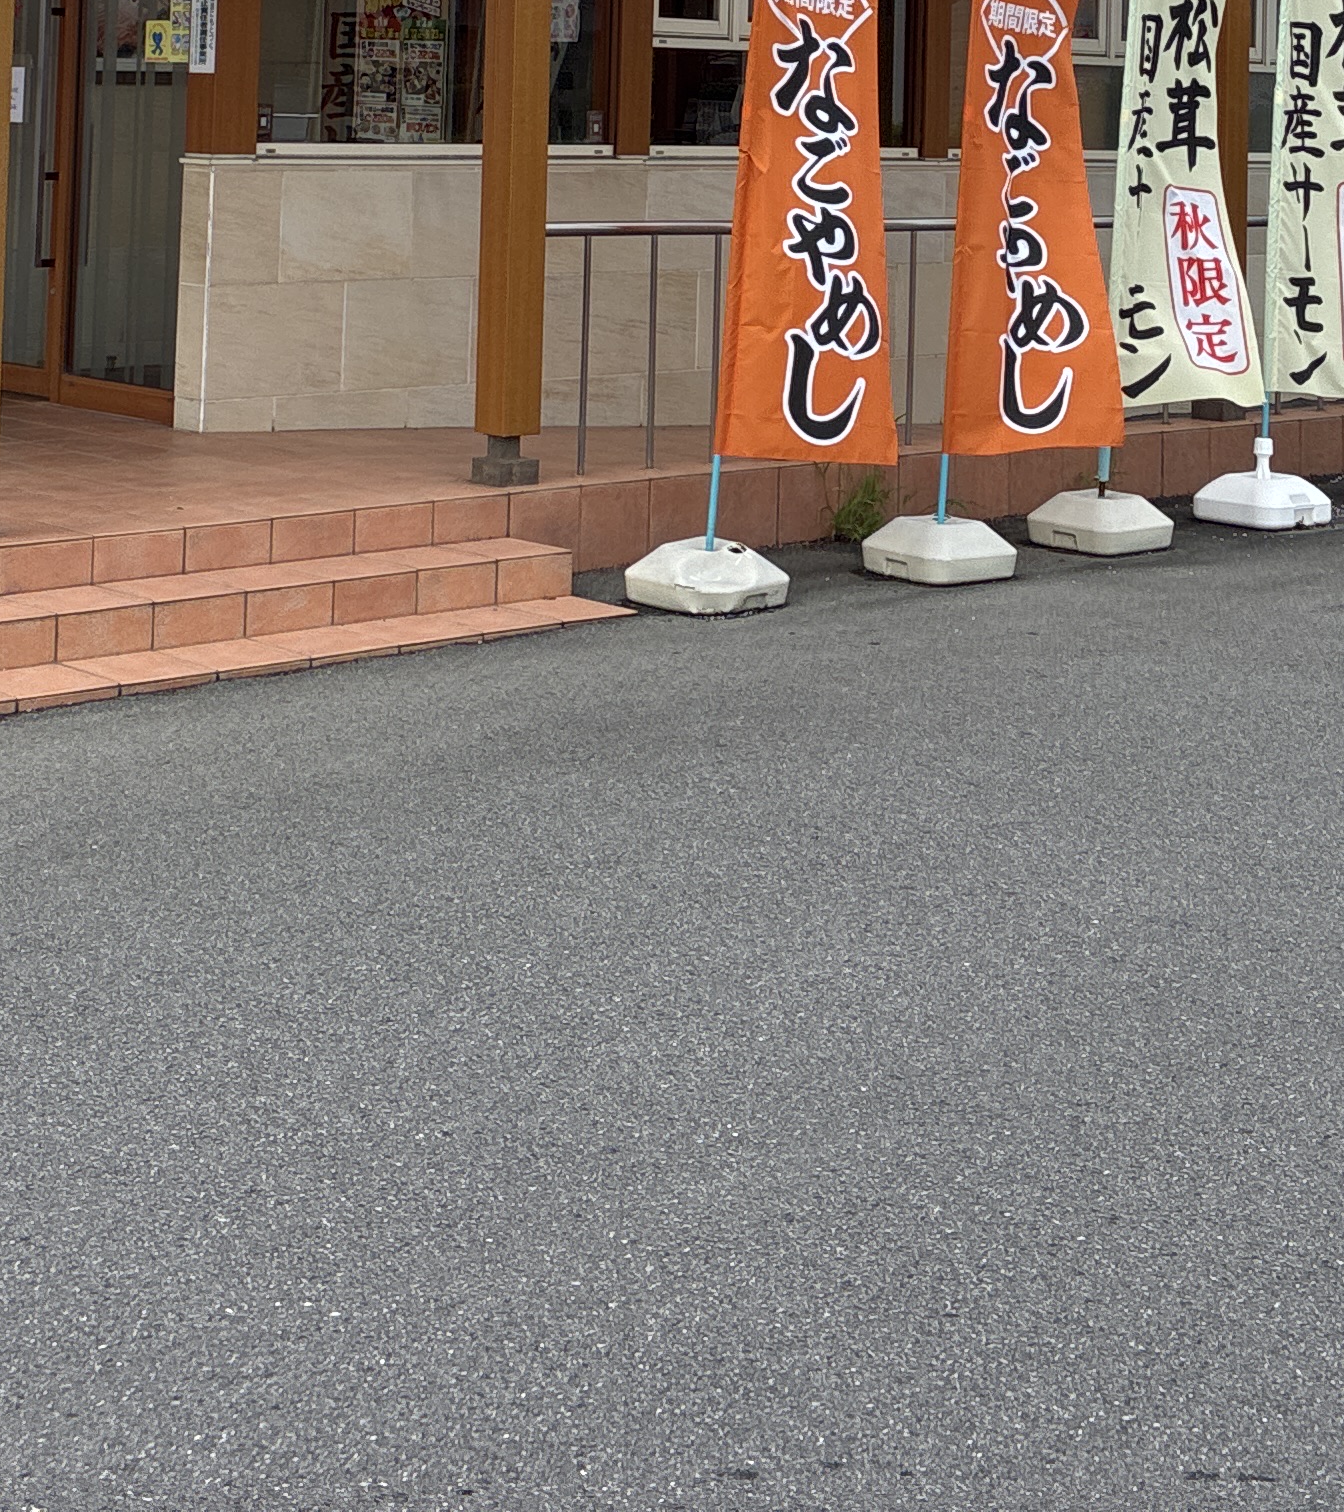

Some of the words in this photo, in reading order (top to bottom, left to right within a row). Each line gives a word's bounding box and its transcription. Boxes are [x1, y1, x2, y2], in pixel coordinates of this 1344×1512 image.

[770, 14, 882, 446] なごやめし
[1169, 199, 1239, 365] 秋限定
[1281, 21, 1328, 386] 国産サーモン
